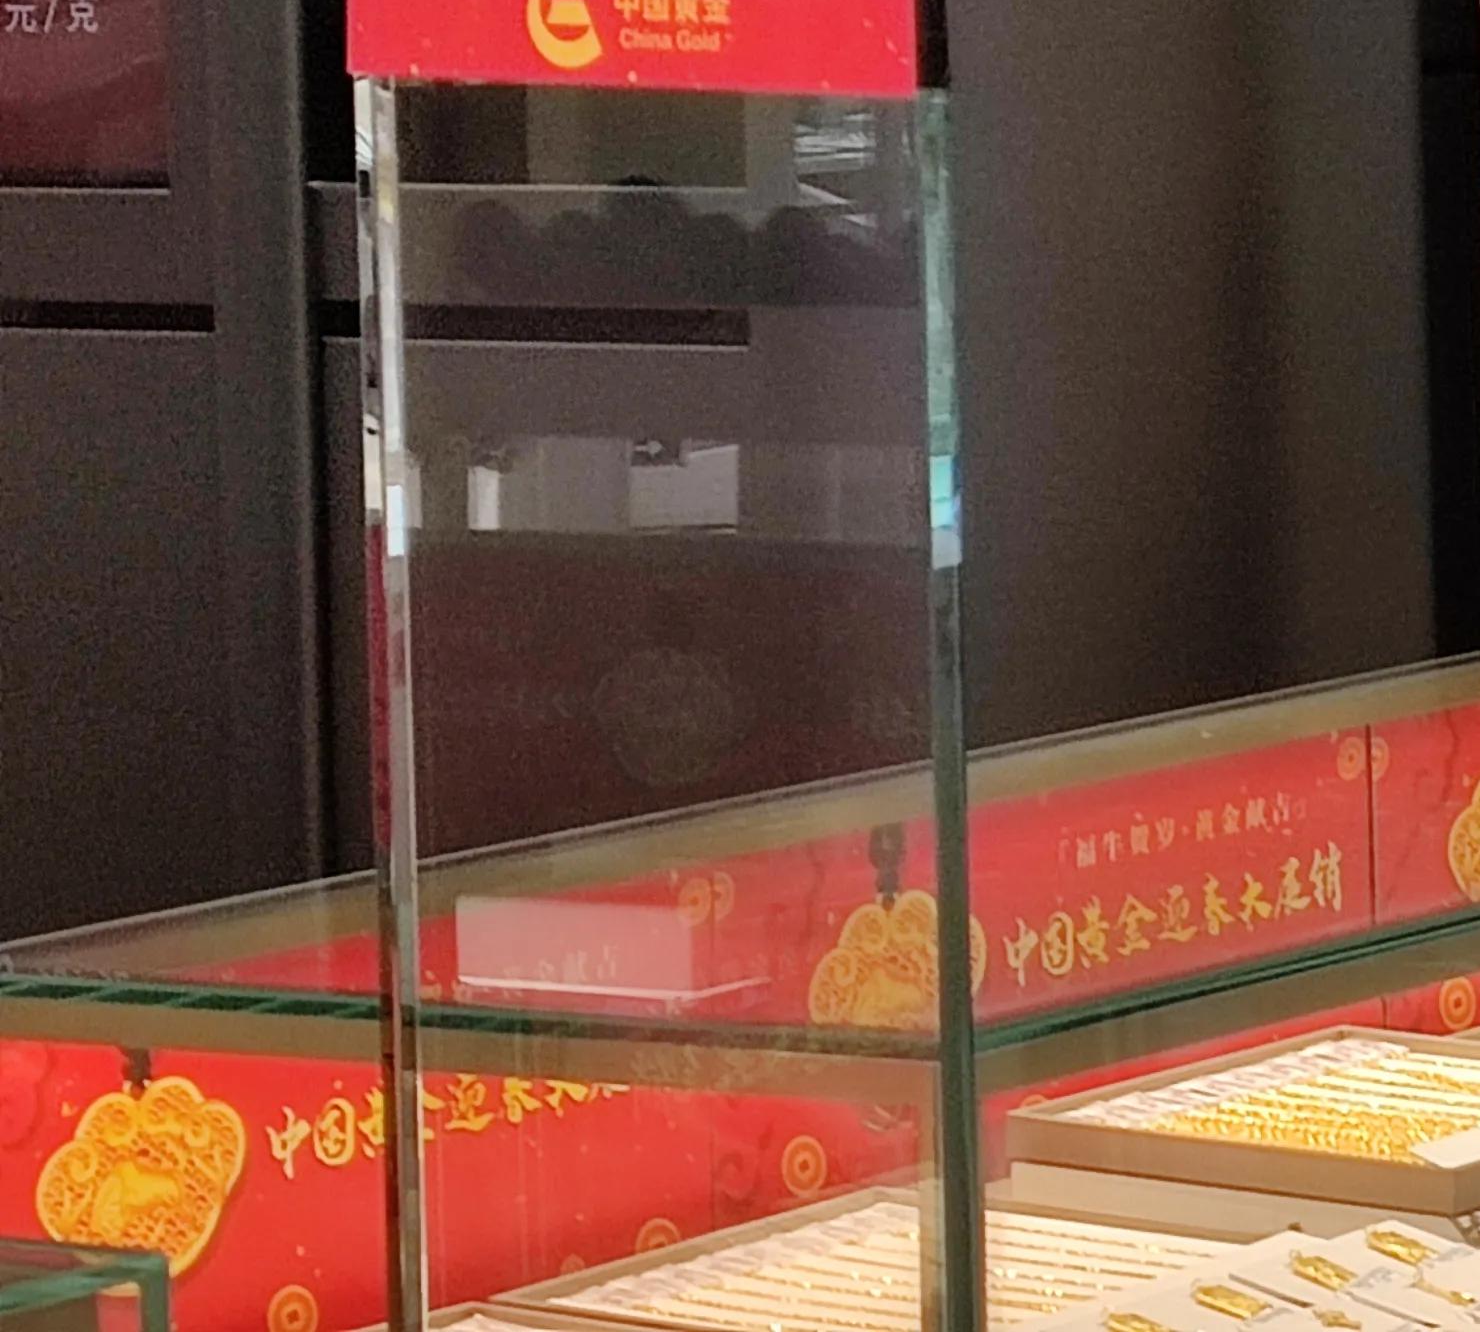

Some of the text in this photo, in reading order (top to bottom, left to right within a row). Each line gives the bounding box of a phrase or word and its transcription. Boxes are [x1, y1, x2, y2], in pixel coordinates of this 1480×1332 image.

[618, 27, 722, 54] China Gold
[1002, 839, 1343, 988] 中国黄金迎春大展销
